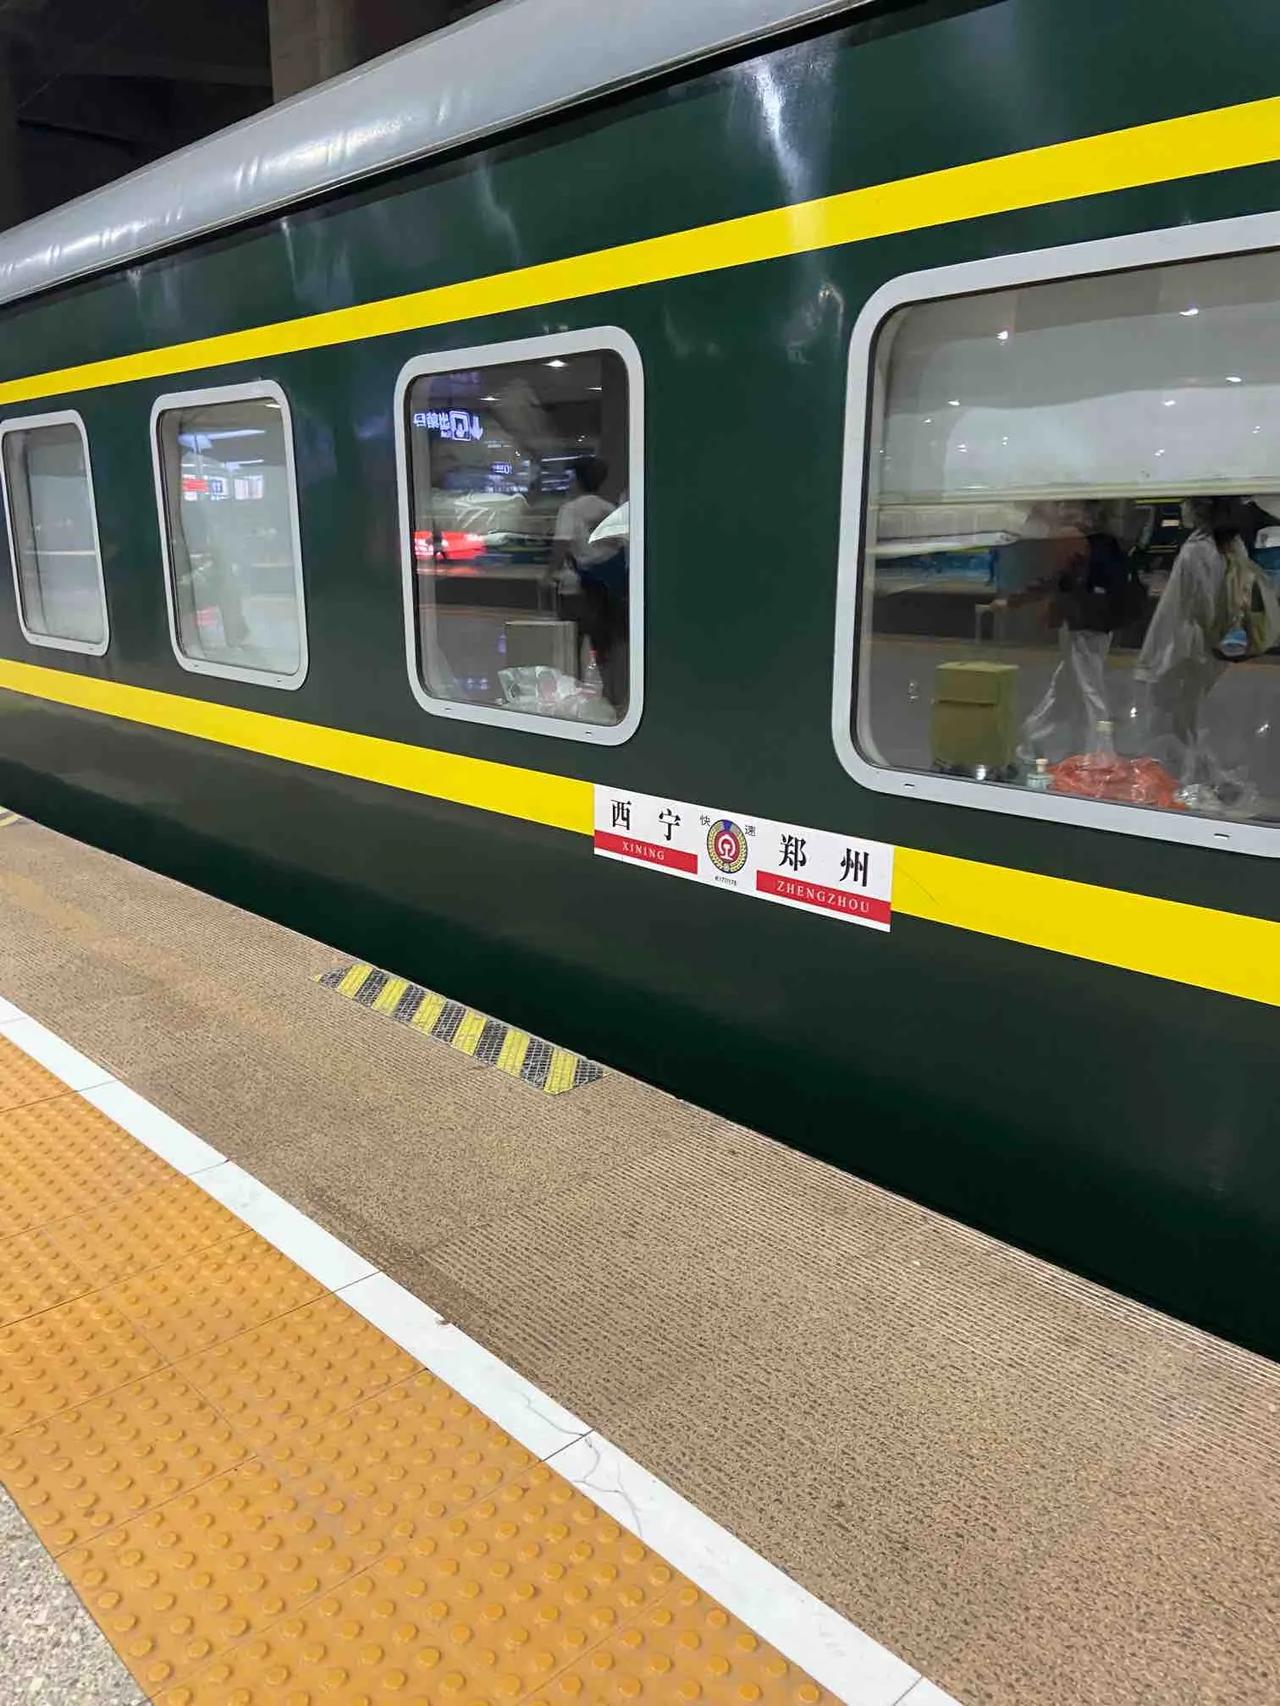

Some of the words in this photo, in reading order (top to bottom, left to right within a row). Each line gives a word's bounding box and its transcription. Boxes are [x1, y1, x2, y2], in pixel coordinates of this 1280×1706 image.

[610, 799, 681, 841] 西宁
[700, 814, 756, 837] 快速
[622, 840, 665, 861] XINING
[778, 833, 869, 887] 郑州
[776, 880, 870, 913] ZHENGZHOU
